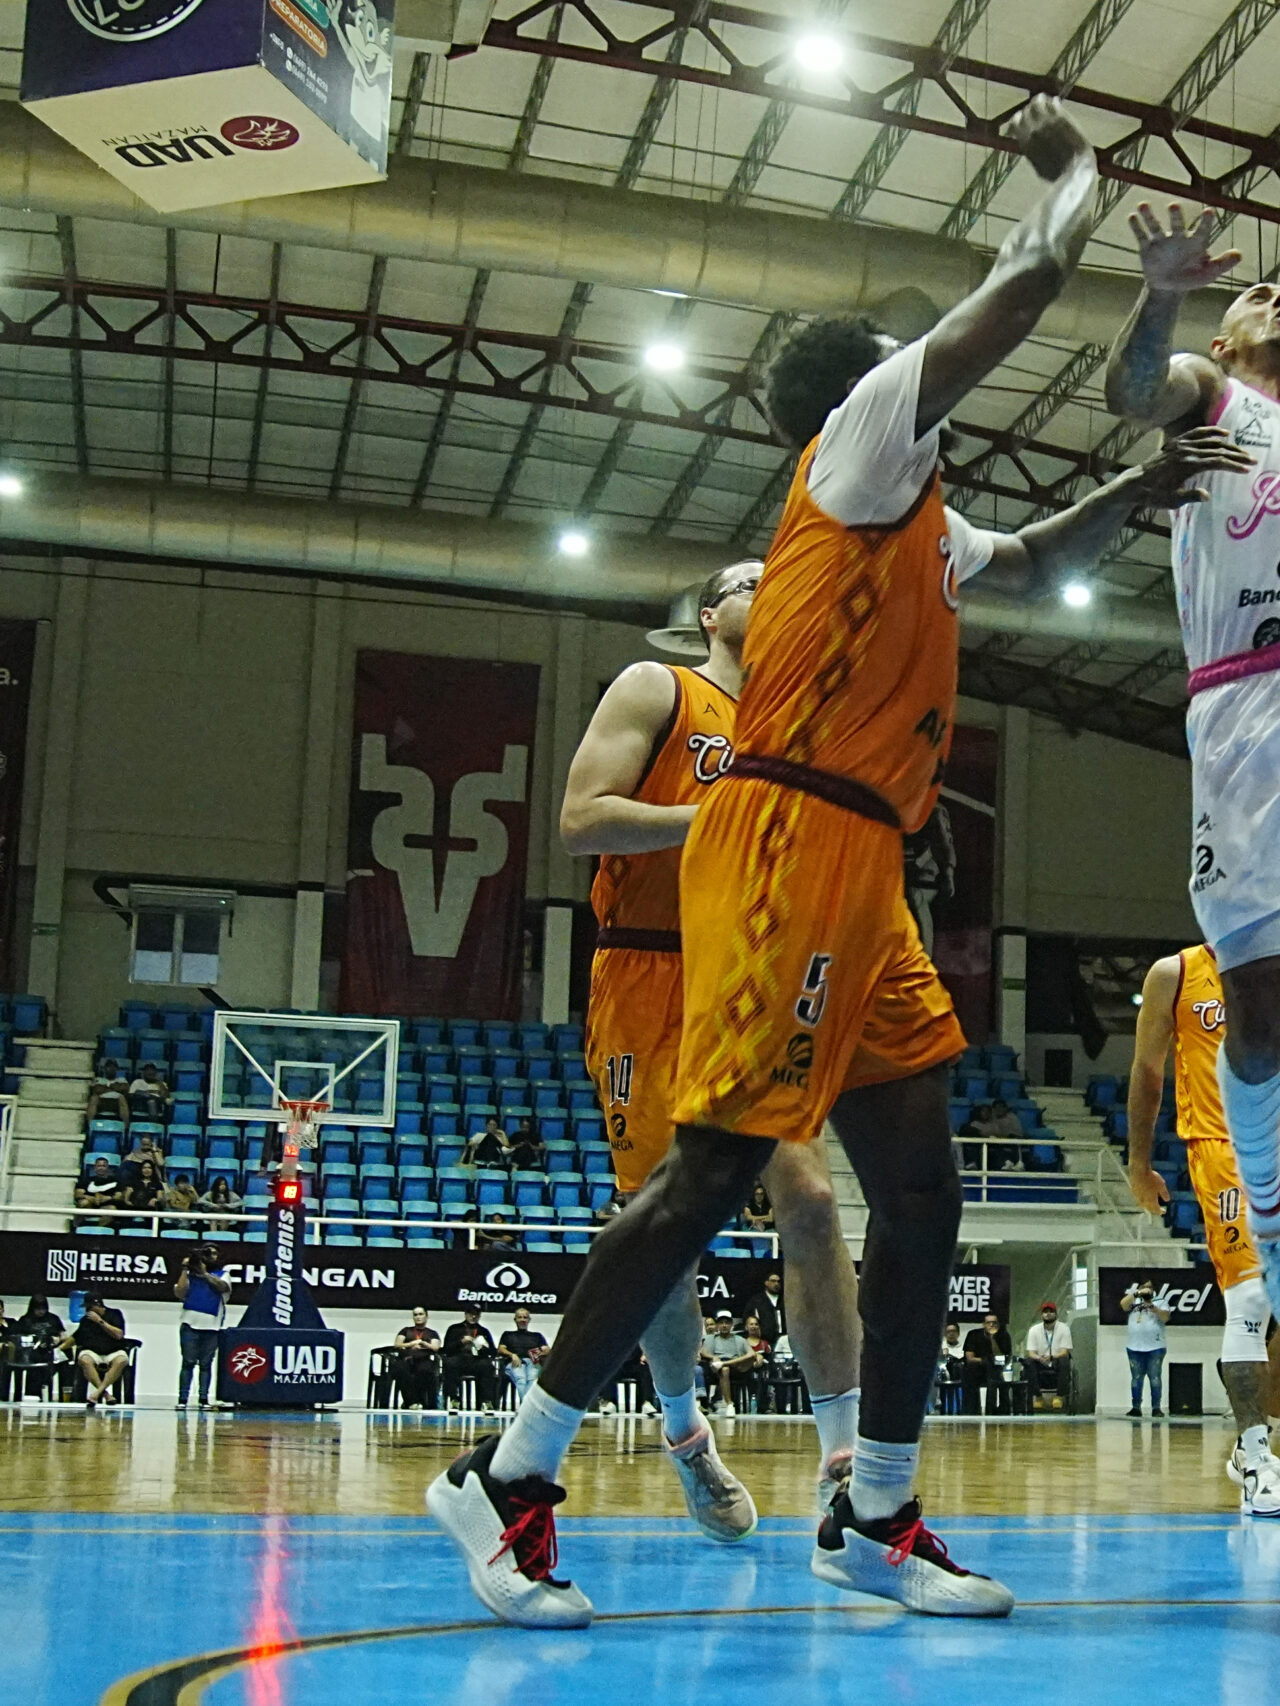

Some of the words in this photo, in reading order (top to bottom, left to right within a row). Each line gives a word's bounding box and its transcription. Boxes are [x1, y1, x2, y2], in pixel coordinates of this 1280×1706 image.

[101, 125, 208, 146] MAZATLAN
[115, 134, 235, 168] UAD
[795, 952, 833, 1028] 5
[607, 1053, 634, 1107] 14
[1218, 1187, 1241, 1226] 10
[80, 1252, 168, 1275] HERSA
[272, 1209, 295, 1326] dportenis
[90, 1277, 161, 1285] CORPORATIVO
[222, 1264, 395, 1289] CHNGAN
[458, 1288, 504, 1302] Banco
[505, 1290, 557, 1304] Azteca
[948, 1294, 991, 1312] ADE
[273, 1345, 337, 1375] UAD
[273, 1374, 336, 1385] MAZATLAN
